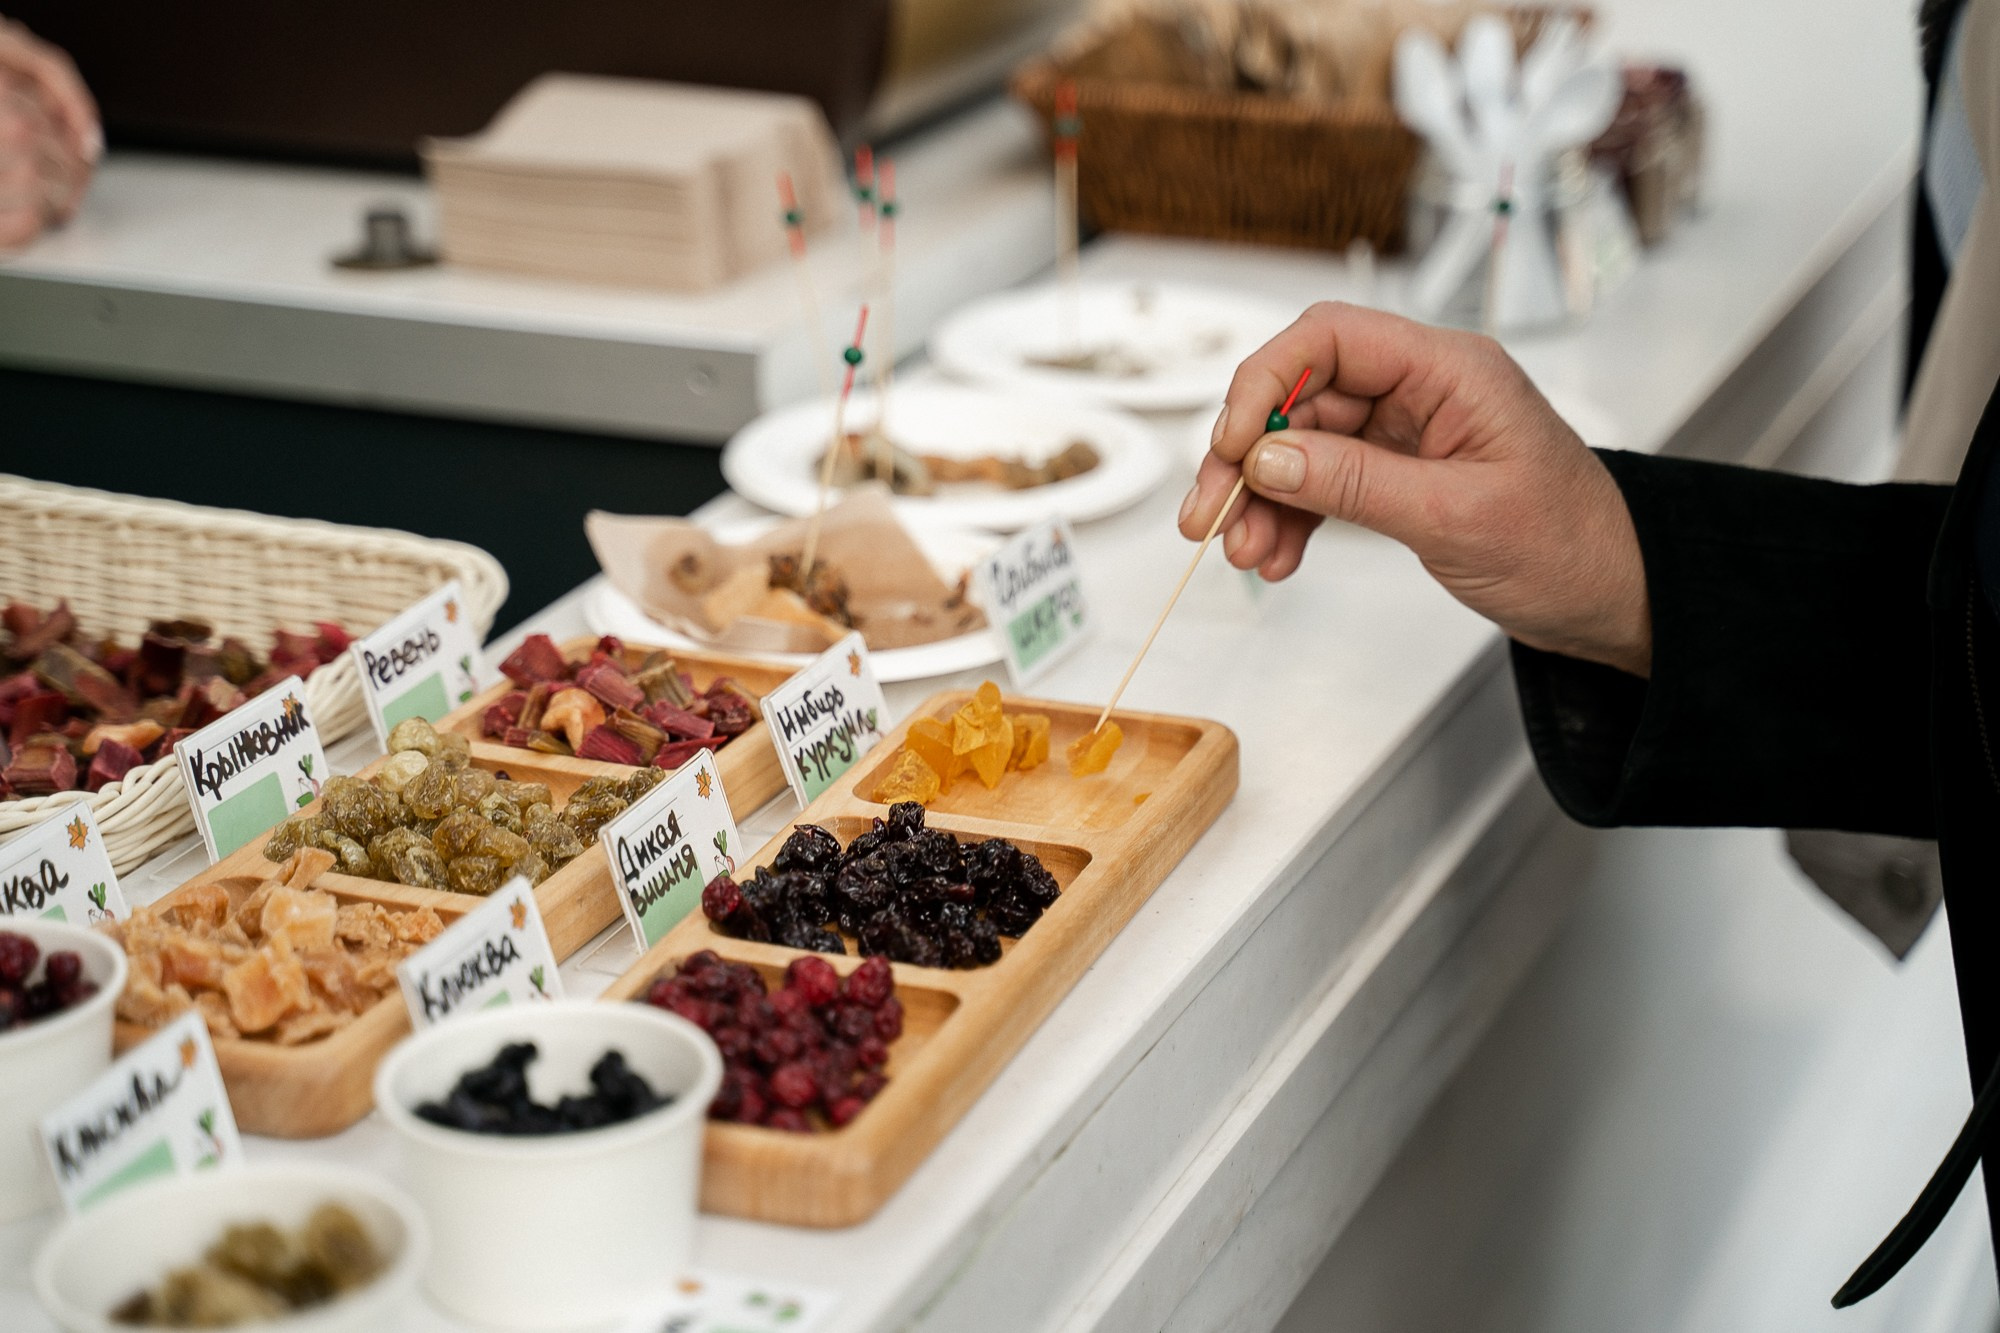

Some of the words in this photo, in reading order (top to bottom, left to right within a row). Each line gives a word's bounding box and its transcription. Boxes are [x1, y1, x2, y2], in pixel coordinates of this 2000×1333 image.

[364, 628, 440, 691] Ревень
[777, 685, 844, 742] Имбирь
[617, 809, 682, 883] Дикая
[629, 843, 699, 918] вишня
[418, 934, 521, 1023] Клюква
